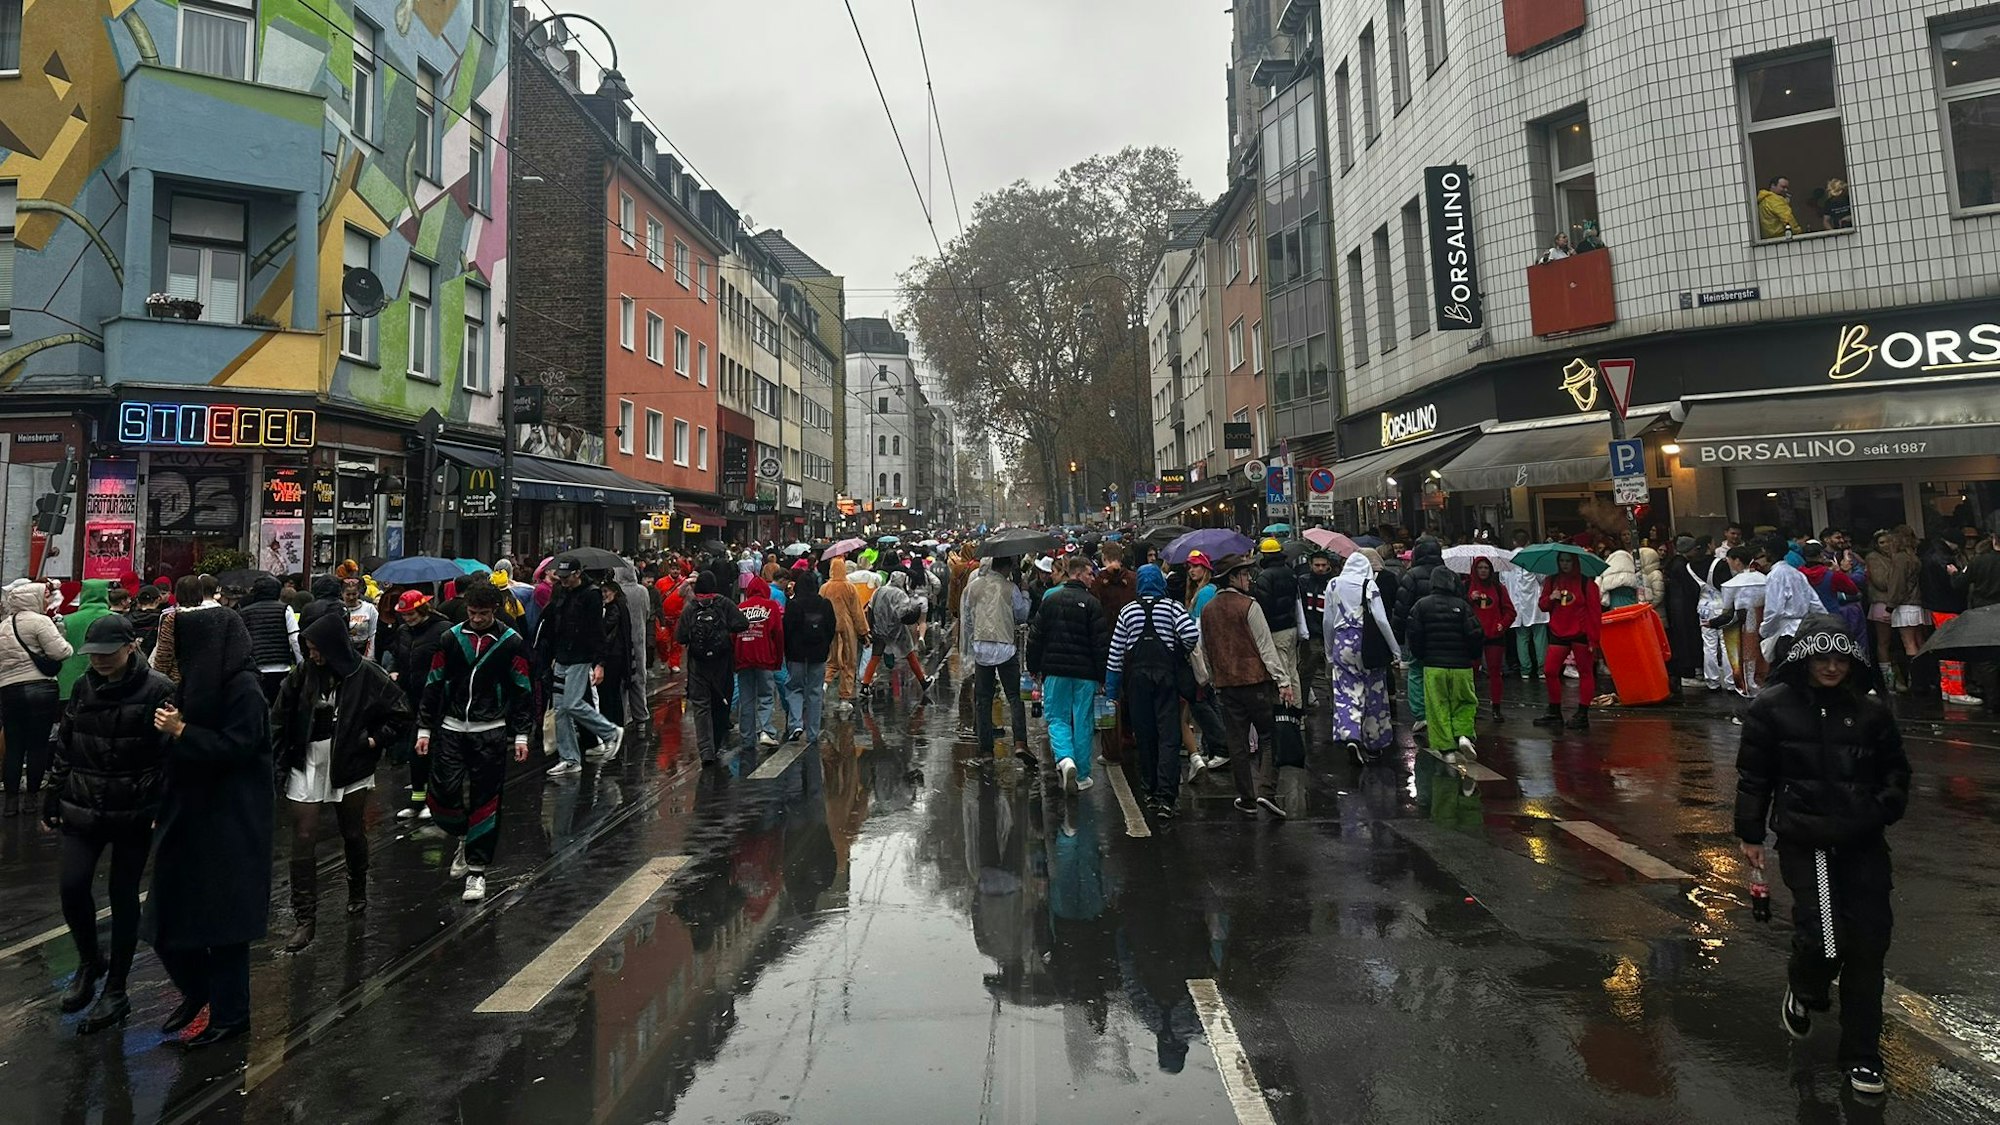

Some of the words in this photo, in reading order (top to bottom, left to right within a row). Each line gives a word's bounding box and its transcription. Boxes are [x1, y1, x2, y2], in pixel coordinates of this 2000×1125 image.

[1441, 172, 1473, 324] BORSALINO
[1703, 289, 1755, 303] Heinsbergstr.
[122, 406, 311, 443] STIEFEL
[1381, 403, 1437, 446] BORSALINO
[1701, 439, 1856, 462] BORSALINO
[1863, 443, 1890, 455] seit
[1892, 442, 1928, 454] 1987
[263, 482, 302, 491] FANTA
[273, 493, 302, 502] VIER
[1269, 493, 1289, 503] TAX
